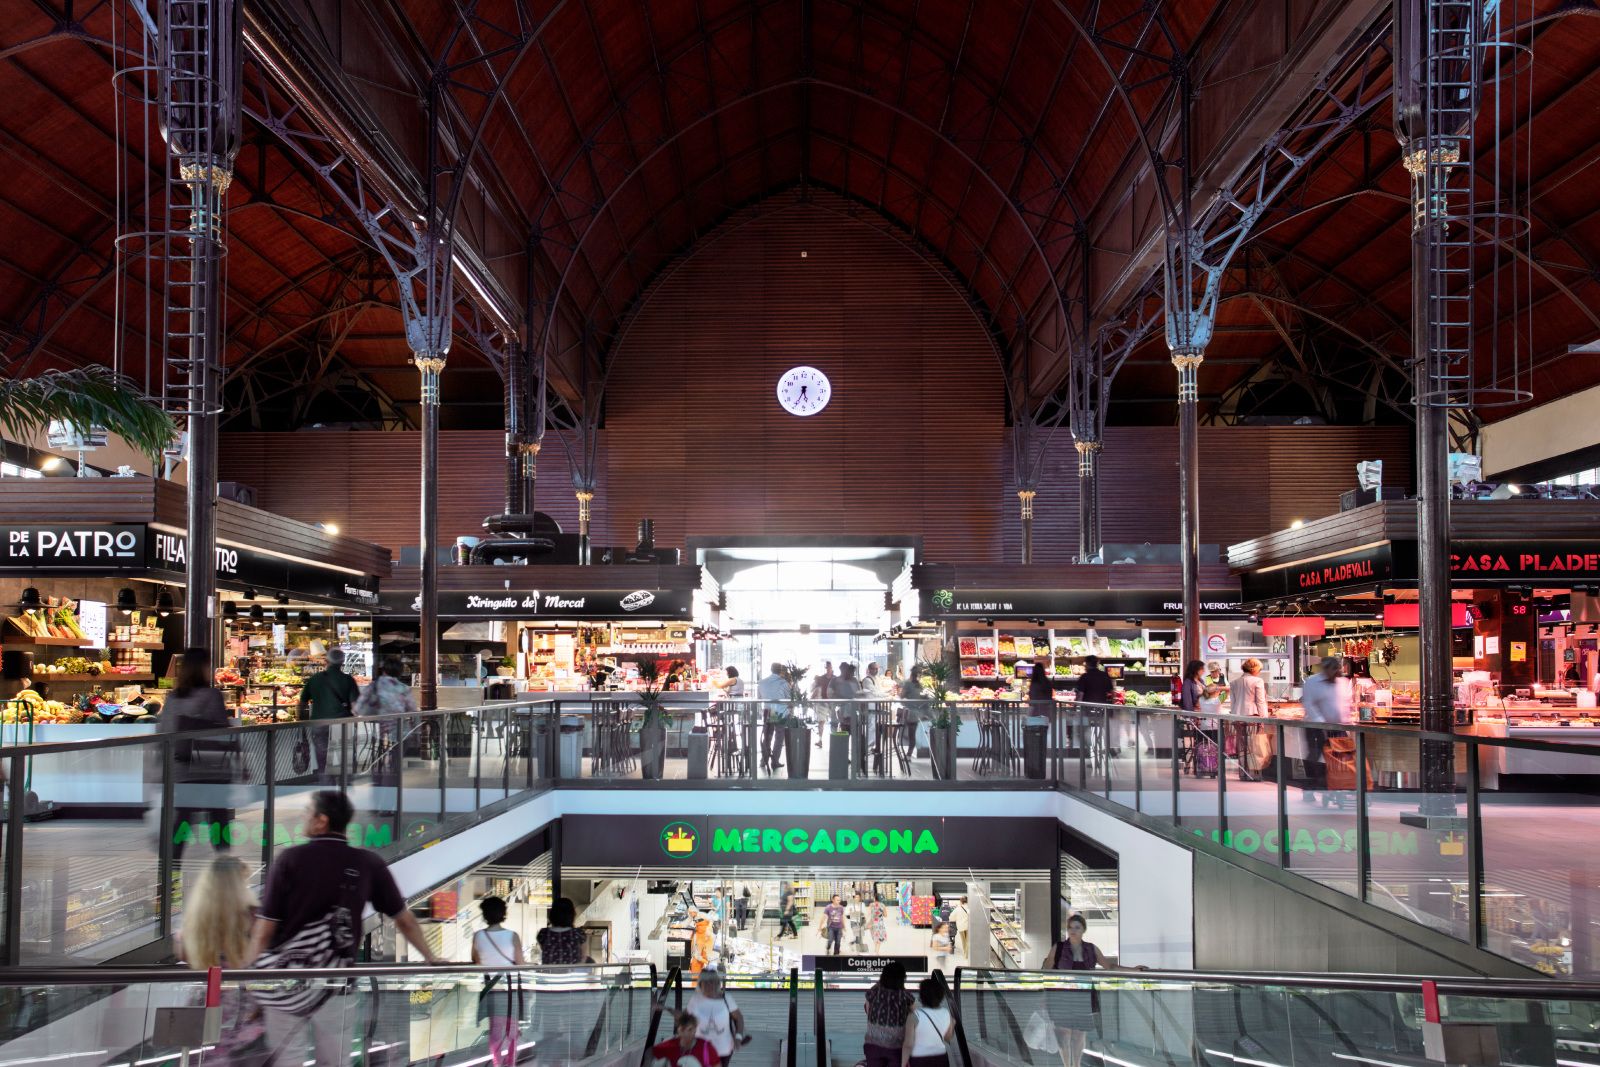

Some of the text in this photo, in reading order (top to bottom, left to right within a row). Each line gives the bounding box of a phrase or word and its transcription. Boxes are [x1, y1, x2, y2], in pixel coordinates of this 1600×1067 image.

[9, 531, 30, 543] DE
[37, 531, 136, 557] PATRO
[9, 545, 30, 557] LA
[155, 533, 238, 573] FILLA TRO
[1450, 554, 1600, 571] CASA PLADE
[1299, 559, 1374, 588] CASA PLADEVALL
[466, 595, 517, 610] Xiringuito
[544, 595, 586, 608] Mercat
[1513, 605, 1527, 614] 58
[712, 828, 939, 854] MERCADONA
[847, 957, 896, 969] Congelat
